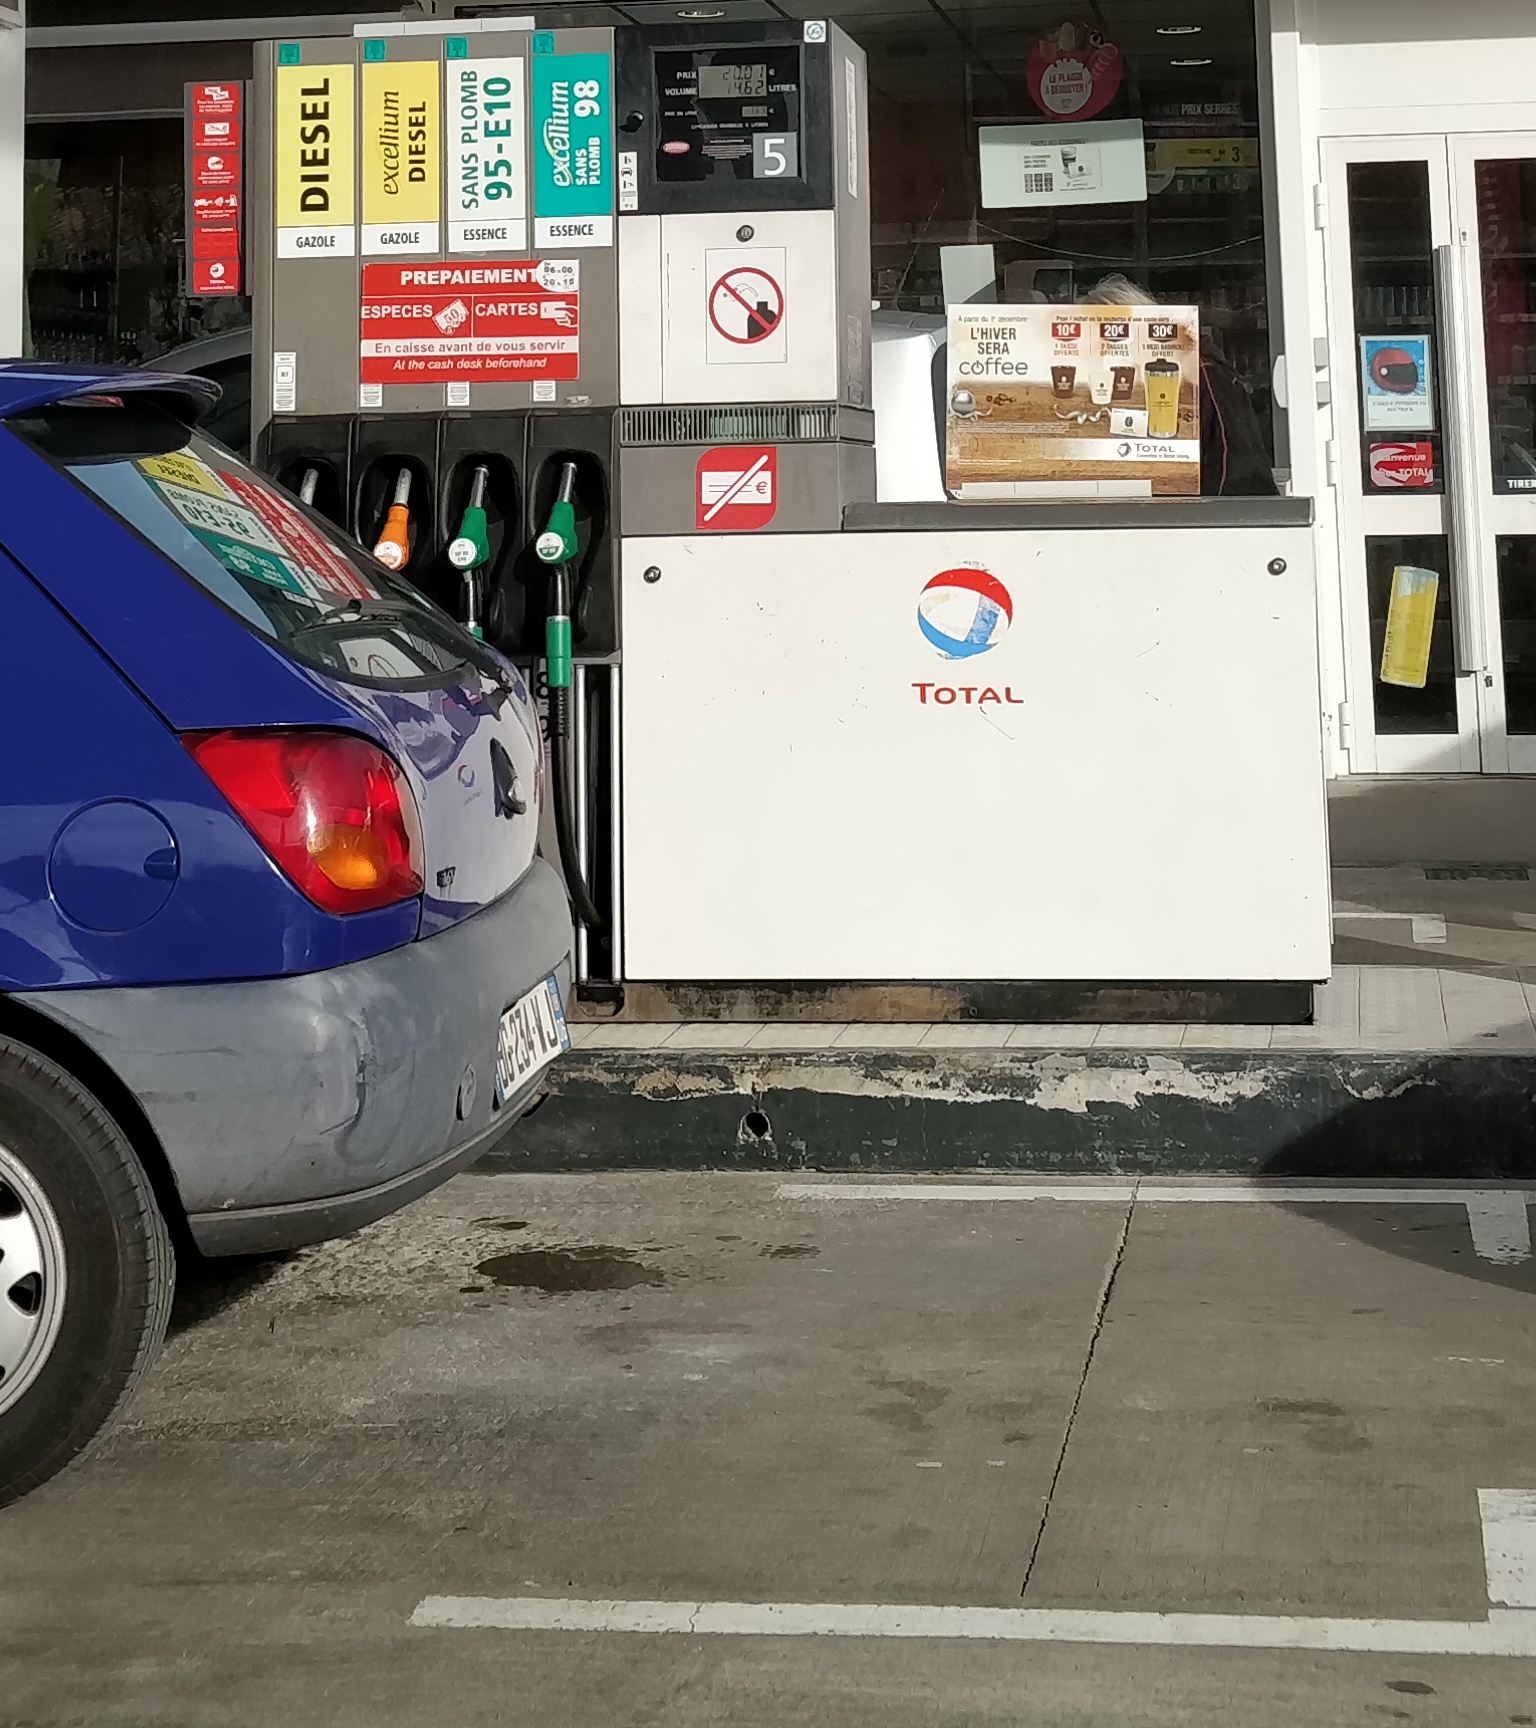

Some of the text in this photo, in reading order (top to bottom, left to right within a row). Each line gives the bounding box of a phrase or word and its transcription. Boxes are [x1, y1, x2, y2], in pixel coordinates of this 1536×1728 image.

[573, 79, 601, 118] 98
[1181, 103, 1202, 115] PRIX
[461, 70, 479, 209] SANS PLOMB
[483, 77, 513, 201] 95-E10
[547, 80, 573, 188] excellium
[300, 77, 330, 213] DIESEL
[379, 90, 400, 195] excellium
[408, 101, 427, 183] DIESEL
[588, 136, 601, 185] PLOMB
[764, 138, 786, 176] 5
[575, 148, 588, 186] SANS
[463, 228, 508, 241] ESSENCE
[549, 224, 594, 237] ESSENCE
[296, 235, 336, 248] GAZOLE
[380, 232, 420, 245] GAZOLE
[400, 268, 537, 286] PREPAIEMENT
[361, 304, 434, 319] ESPECES
[475, 302, 539, 317] CARTES
[970, 326, 1017, 341] L'HIVER
[1055, 324, 1077, 336] 10€
[1103, 323, 1126, 337] 20€
[1152, 323, 1174, 337] 30€
[375, 340, 566, 354] En caisse avant de vous servir
[976, 341, 1010, 356] SERA
[393, 357, 548, 370] At the cash desk beforehand
[958, 357, 1029, 376] coffee
[1133, 442, 1176, 454] TOTAL
[911, 682, 1025, 705] TOTAL
